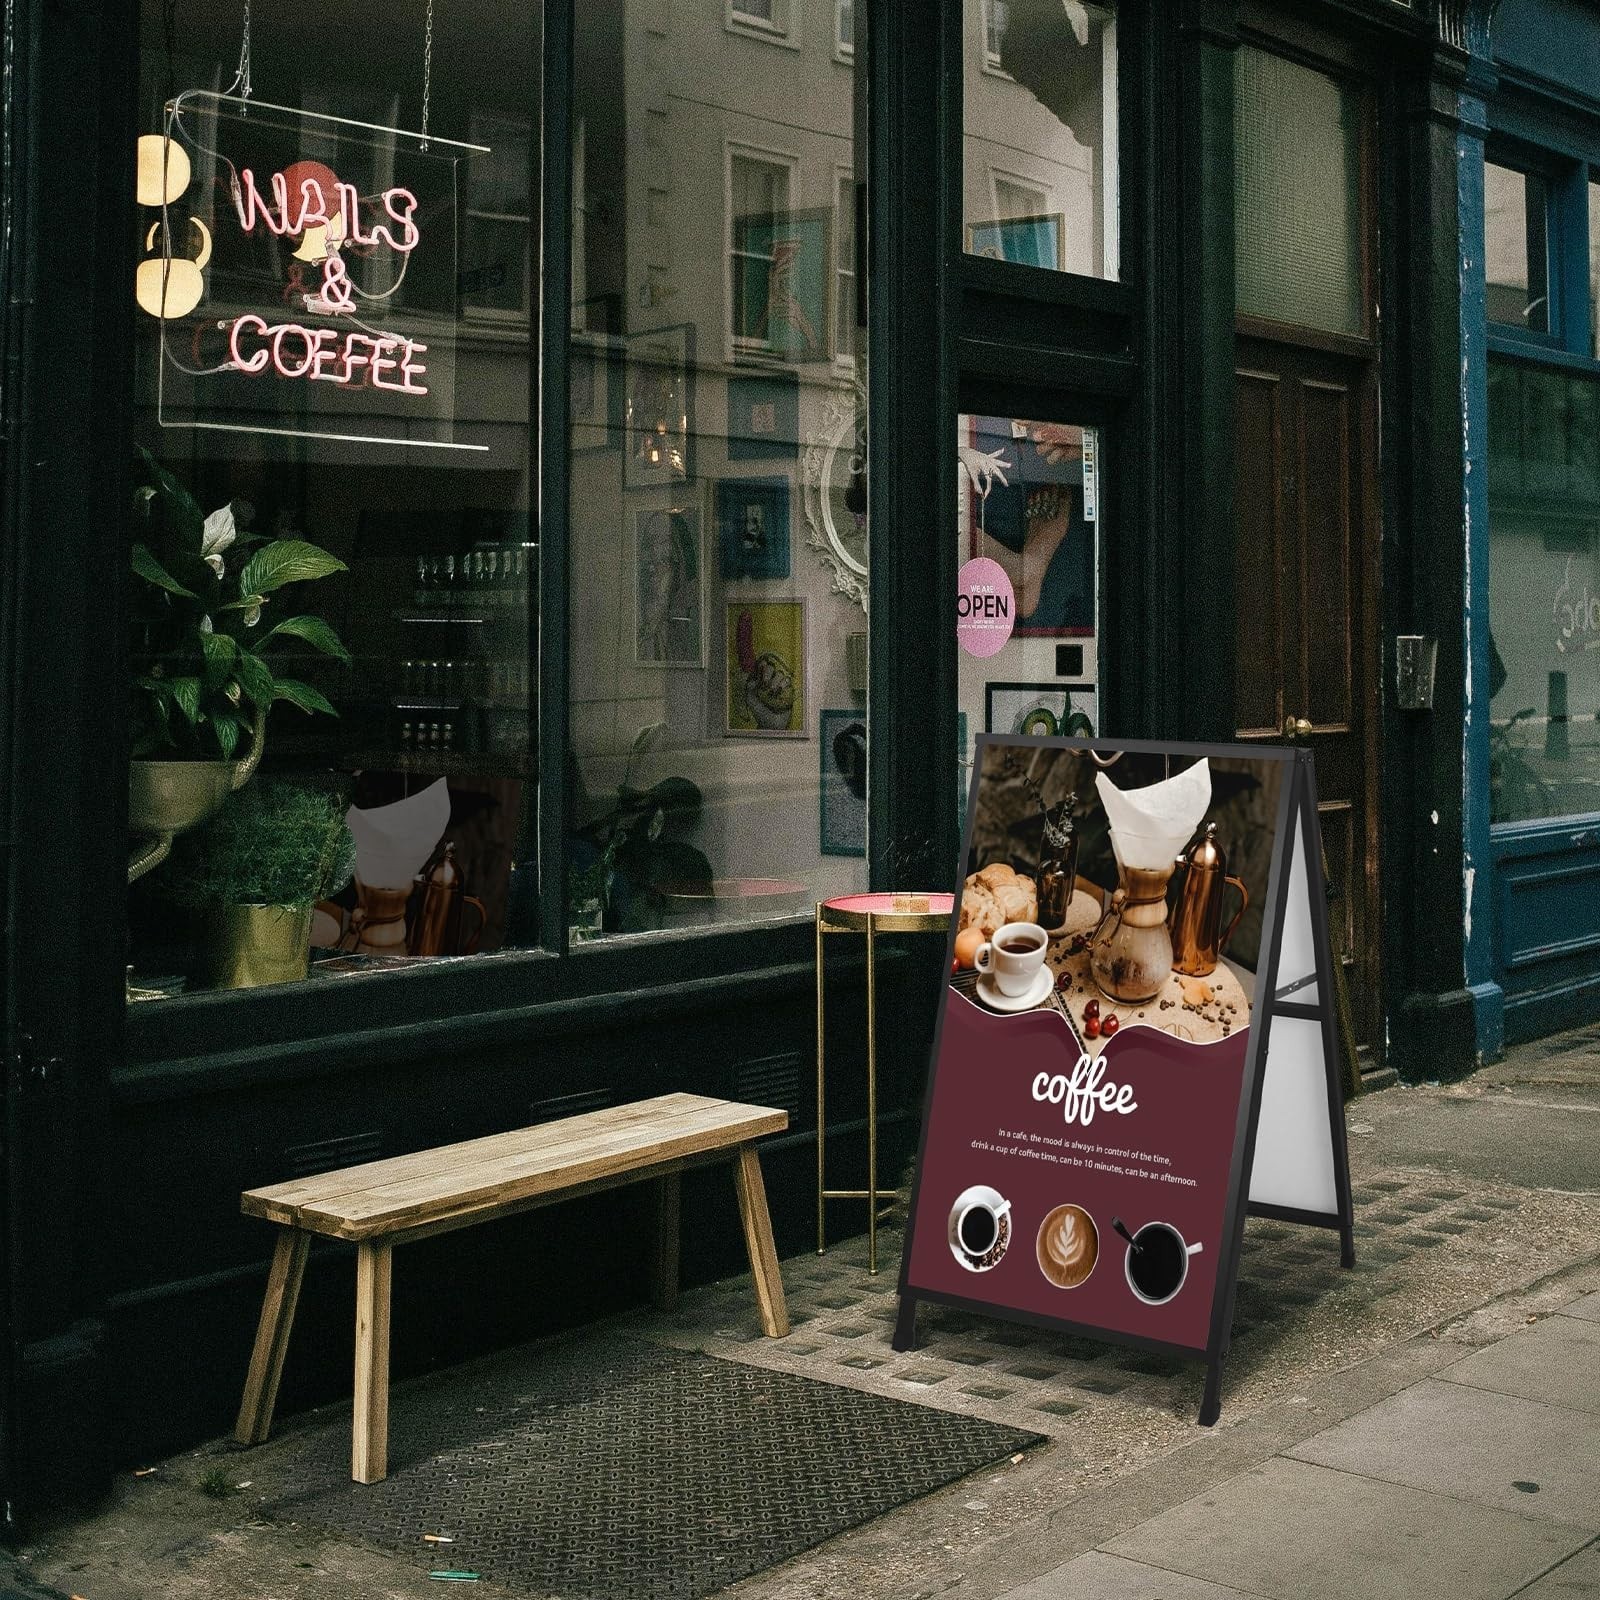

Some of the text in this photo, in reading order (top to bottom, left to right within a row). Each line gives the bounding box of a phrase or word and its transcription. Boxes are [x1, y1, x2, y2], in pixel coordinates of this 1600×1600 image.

[241, 168, 420, 251] NAILS
[320, 257, 357, 313] &
[230, 314, 428, 395] COFFEE
[957, 594, 1008, 618] OPEN
[970, 585, 994, 593] WE ARE
[1031, 1053, 1139, 1127] coffee
[971, 1140, 989, 1150] drink
[995, 1145, 1008, 1155] cup
[1009, 1146, 1018, 1155] of
[1018, 1148, 1040, 1159] coffee
[1041, 1151, 1059, 1163] time,
[1059, 1156, 1072, 1165] can
[1073, 1157, 1083, 1167] be
[1084, 1159, 1093, 1168] 10
[1094, 1161, 1124, 1175] minutes,
[1124, 1167, 1138, 1176] can
[1139, 1168, 1149, 1178] be
[1150, 1172, 1159, 1180] an
[1160, 1173, 1198, 1187] afternoon.
[998, 1128, 1006, 1137] In
[1012, 1131, 1029, 1142] cafe,
[1030, 1133, 1042, 1143] the
[1042, 1137, 1063, 1147] mood
[1064, 1139, 1070, 1148] is
[1071, 1140, 1095, 1153] always
[1095, 1144, 1103, 1153] in
[1104, 1147, 1130, 1158] control
[1130, 1150, 1140, 1159] of
[1140, 1152, 1152, 1162] the
[1153, 1154, 1172, 1167] time,
